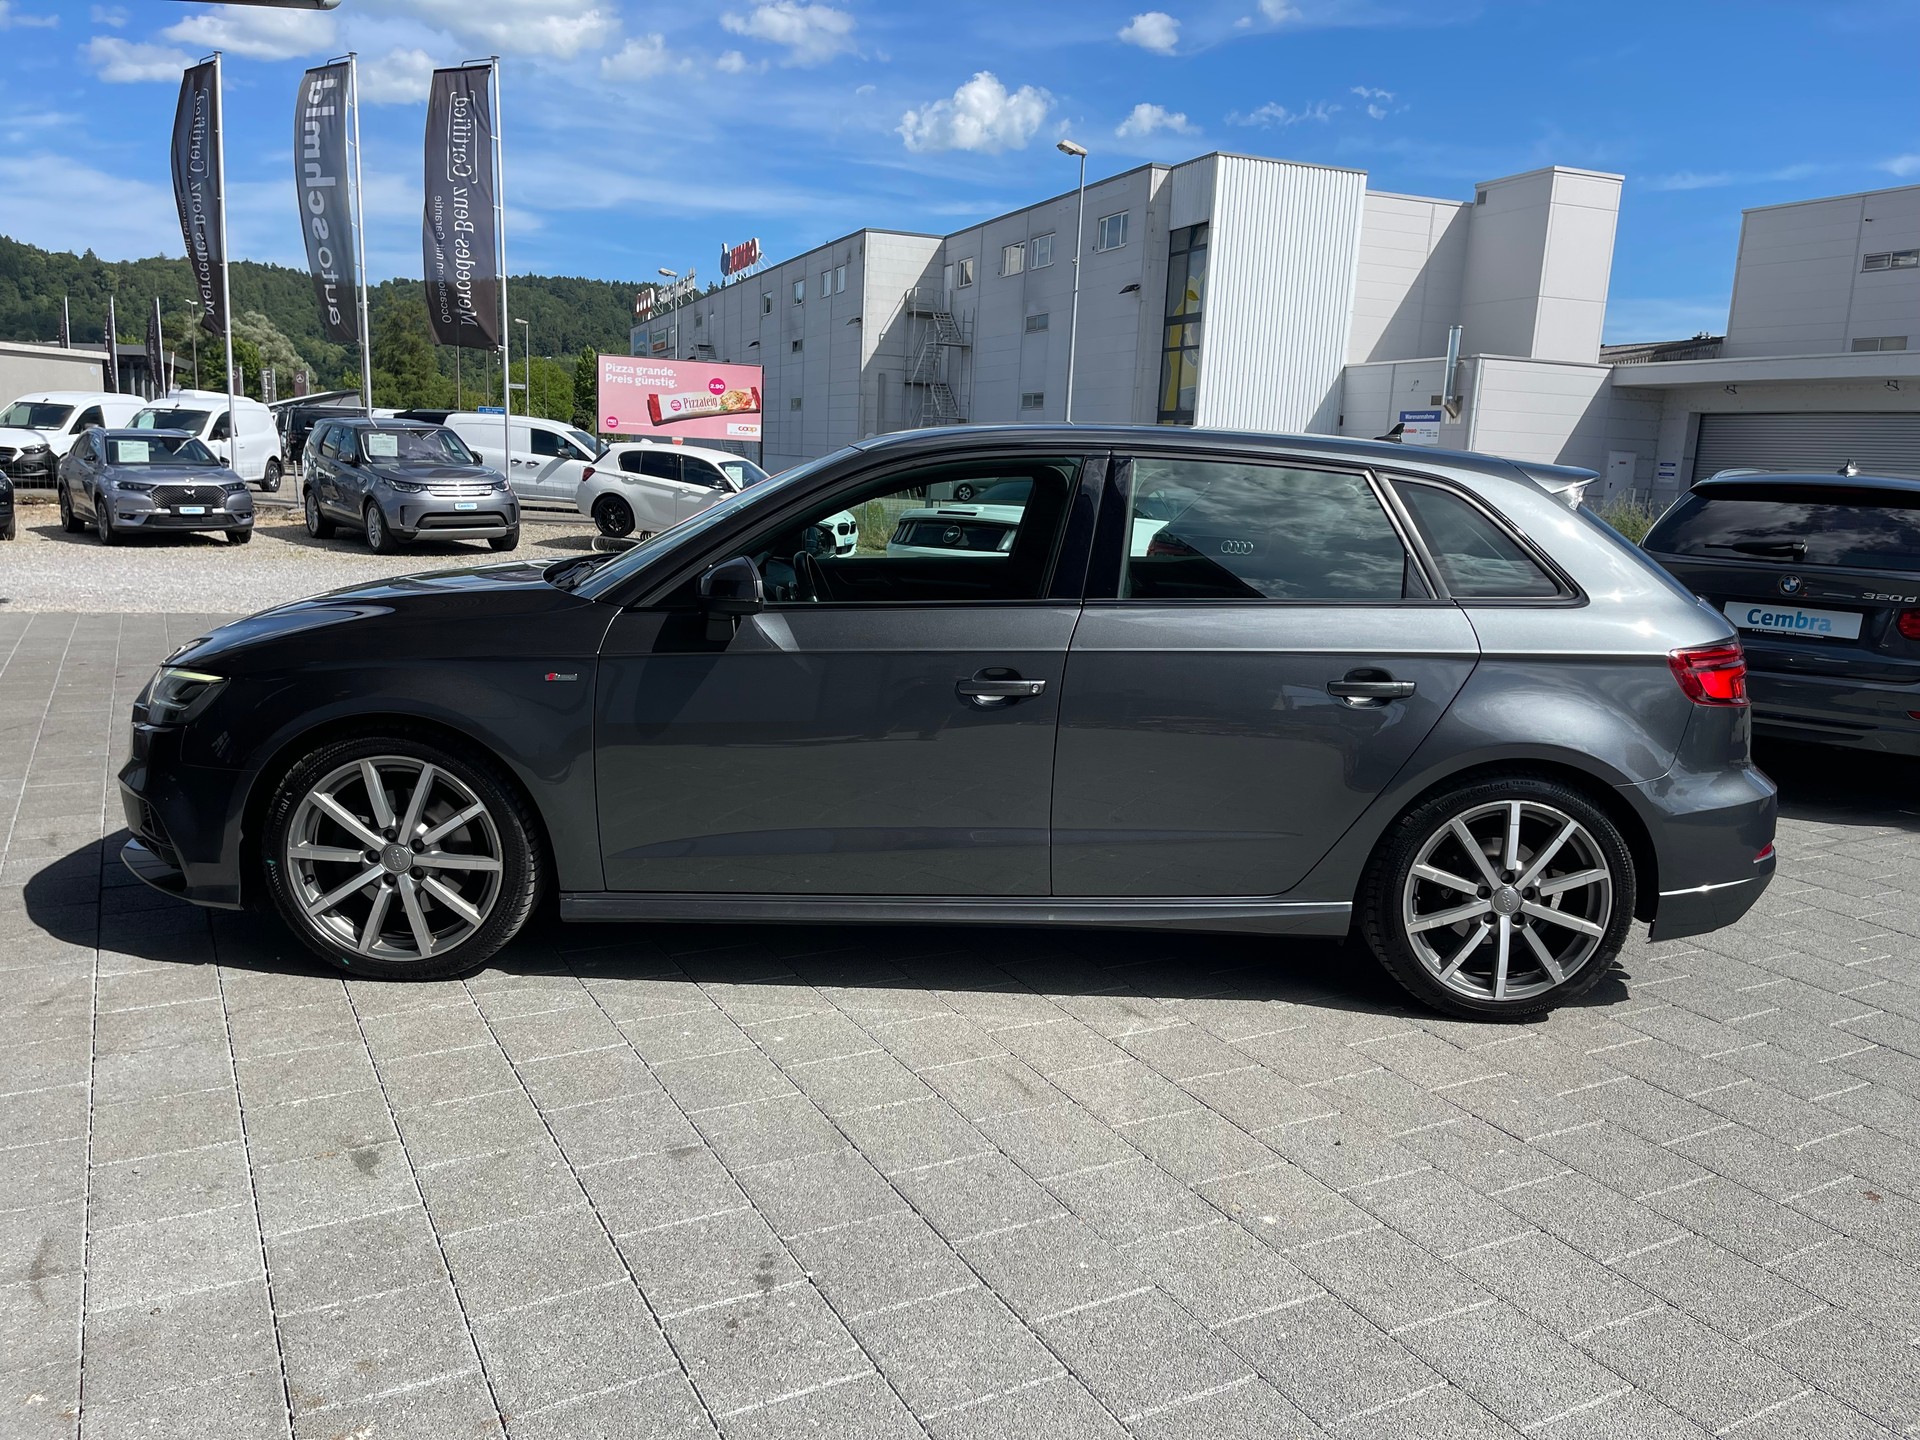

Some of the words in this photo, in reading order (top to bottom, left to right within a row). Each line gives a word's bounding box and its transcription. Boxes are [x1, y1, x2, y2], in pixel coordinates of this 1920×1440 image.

[605, 362, 634, 374] Pizza
[636, 367, 677, 377] grande.
[605, 373, 633, 384] Preis
[635, 375, 678, 389] günstig.
[683, 396, 718, 409] Pizzateig
[1747, 608, 1832, 633] Cembra
